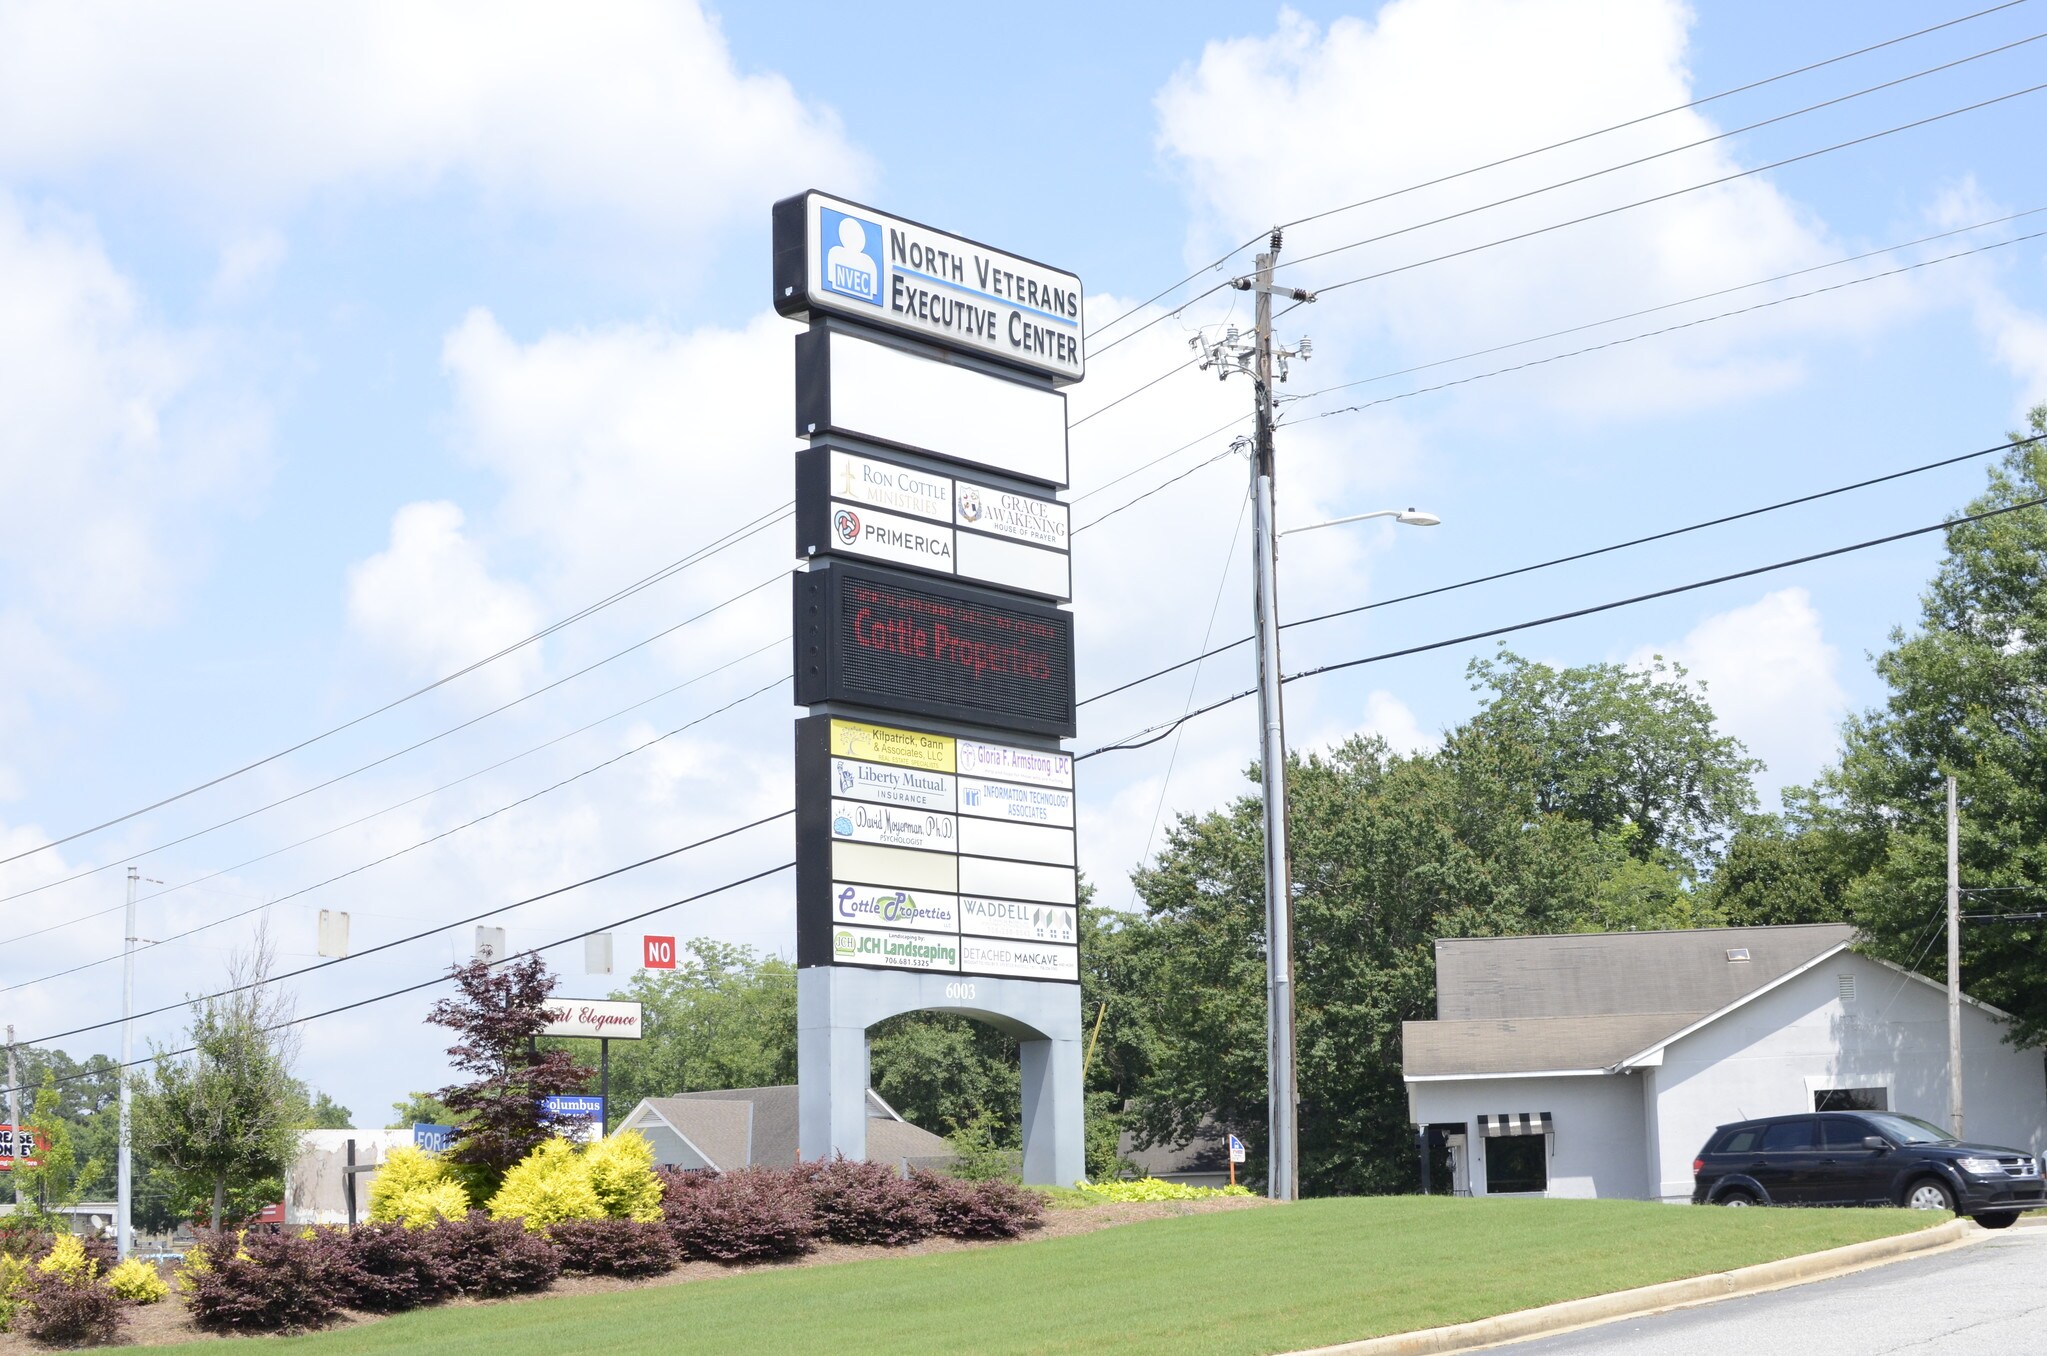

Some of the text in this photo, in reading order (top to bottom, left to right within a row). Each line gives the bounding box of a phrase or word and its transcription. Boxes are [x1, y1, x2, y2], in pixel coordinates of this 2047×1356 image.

[836, 267, 870, 293] NVEC
[867, 488, 938, 515] MINISTRIES
[1001, 495, 1048, 519] GRACE
[984, 506, 1065, 537] AWAKENING
[994, 522, 1057, 543] HOUSE OF PRAYER
[865, 524, 951, 558] PRIMERICA
[853, 607, 927, 657] Cottle
[872, 729, 944, 750] Kilpatrick, Gann
[873, 742, 880, 752] &
[927, 751, 943, 762] LLC
[978, 745, 1001, 765] Gloria
[1012, 751, 1051, 776] Armstrong
[1055, 757, 1069, 775] LPC
[858, 766, 900, 790] Liberty
[877, 790, 927, 804] INSURANCE
[983, 785, 1028, 803] INFORMATION
[1029, 791, 1070, 808] TECHNOLOGY
[855, 806, 883, 830] David
[1008, 804, 1048, 820] ASSOCIATES
[880, 834, 923, 846] PSYCHOLOGIST
[838, 887, 952, 924] Cottle Properties
[964, 899, 1030, 921] WADDELL
[835, 937, 853, 948] JCH
[888, 933, 917, 941] Landscaping
[649, 941, 671, 963] NO
[857, 936, 956, 965] JCH Landscaping
[963, 947, 1011, 962] DETACHED
[1014, 952, 1059, 967] MANCAVE
[885, 957, 930, 967] 706.681.5325
[946, 982, 976, 1000] 6003
[578, 1006, 638, 1031] Elegance
